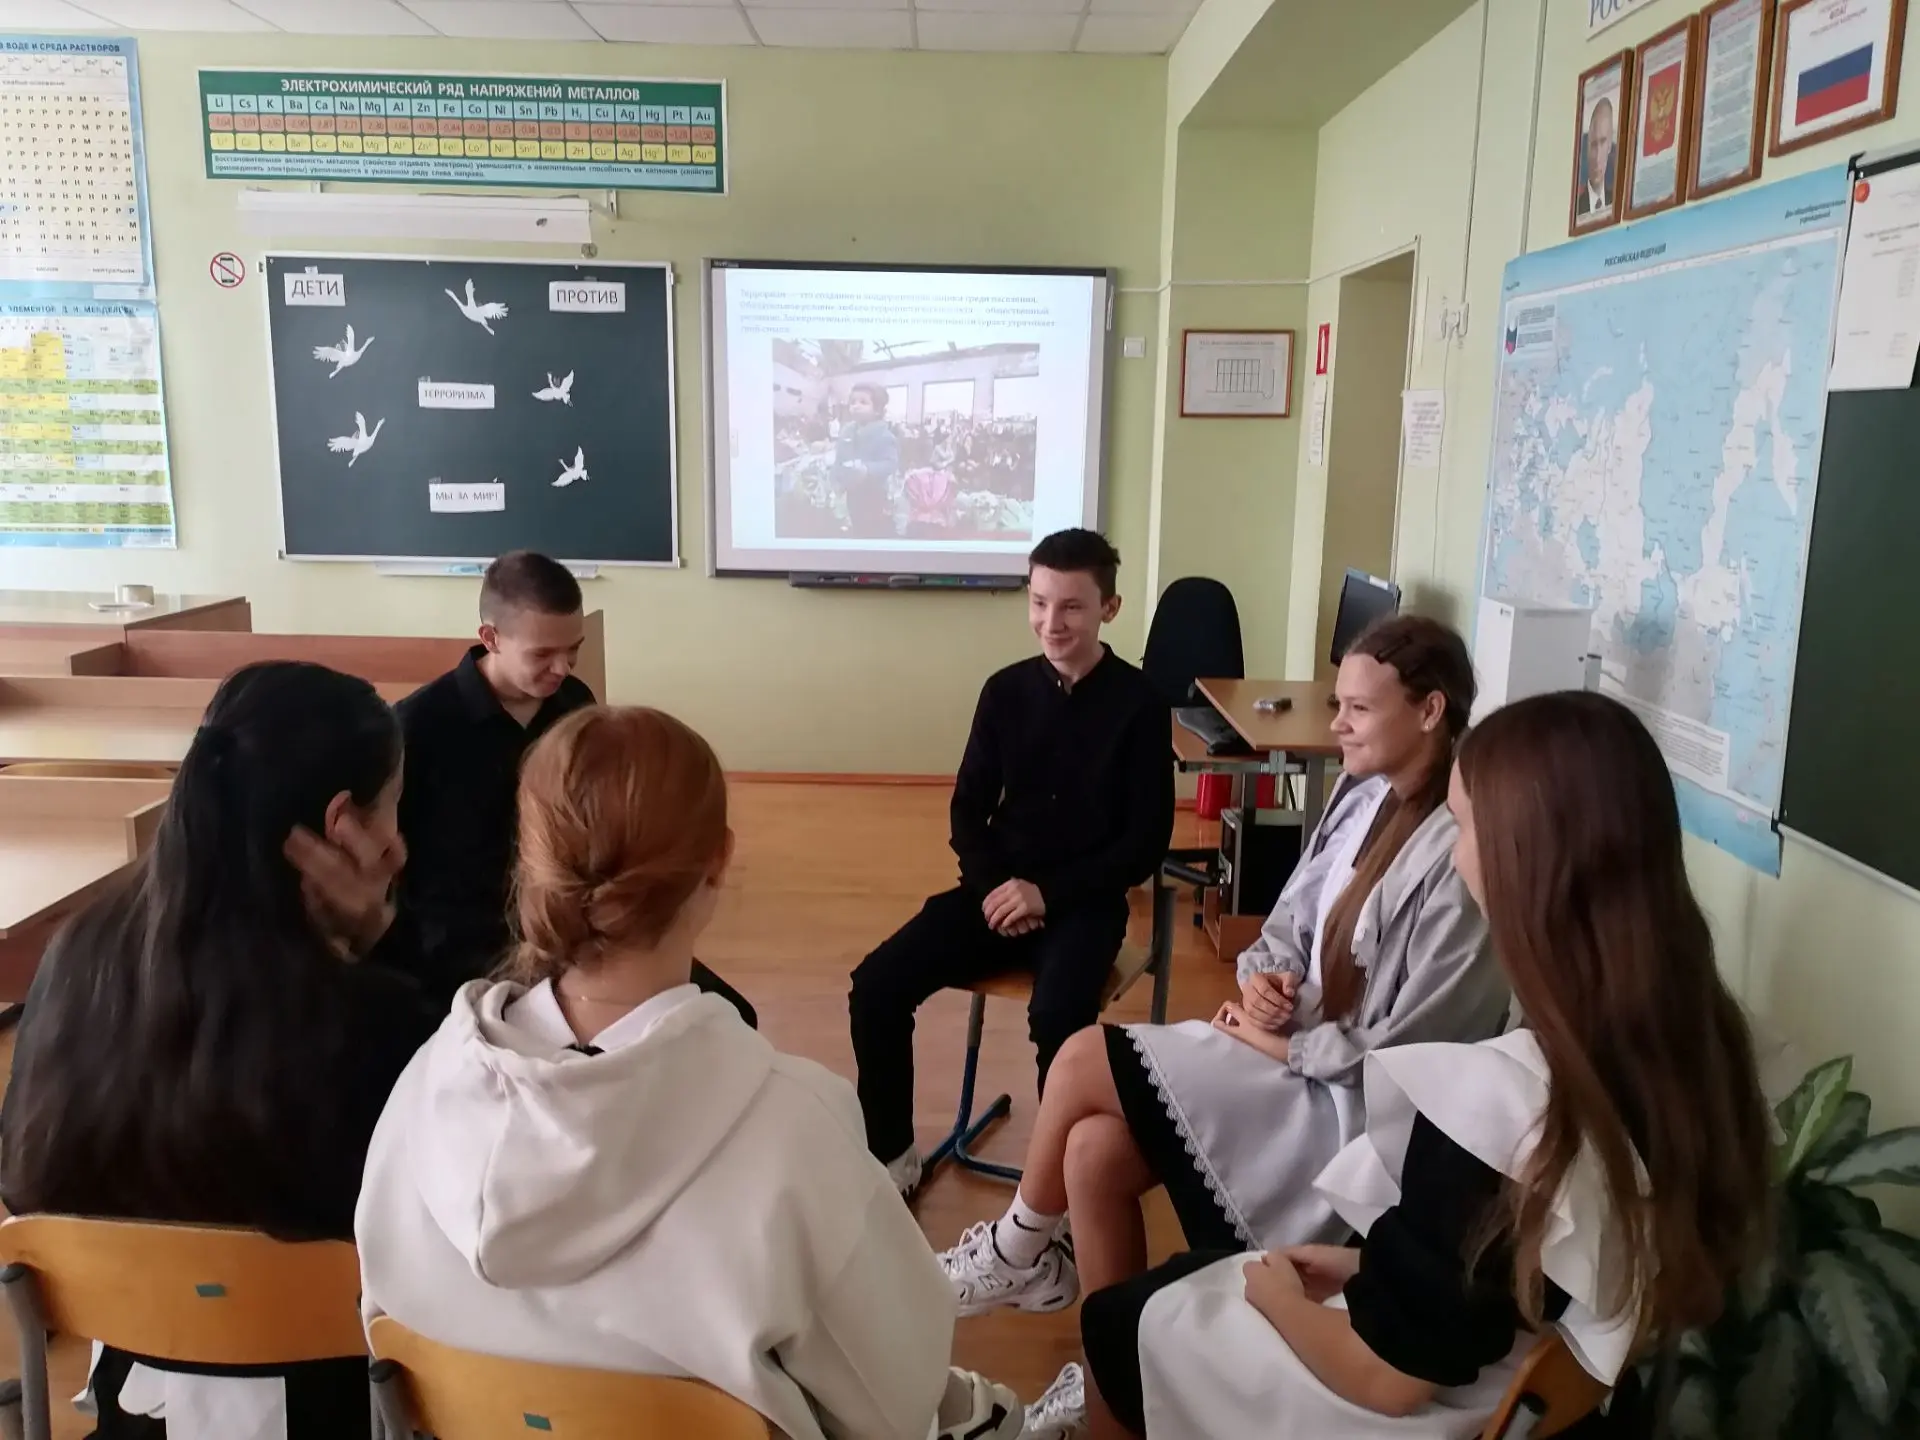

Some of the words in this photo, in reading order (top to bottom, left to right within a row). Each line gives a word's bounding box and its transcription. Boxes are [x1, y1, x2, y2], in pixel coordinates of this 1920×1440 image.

[6, 42, 29, 50] ВОДЕ
[40, 43, 67, 51] СРЕДА
[70, 43, 120, 52] РАСТВОРОВ
[281, 78, 432, 95] ЭЛЕКТРОХИМИЧЕСКИЙ
[438, 83, 464, 97] РЯД
[470, 83, 563, 99] НАПРЯЖЕНИЙ
[568, 86, 640, 100] МЕТАЛЛОВ
[215, 97, 224, 108] Li
[239, 99, 252, 108] Cs
[266, 99, 273, 108] K
[289, 100, 303, 110] Ba
[315, 100, 328, 110] Ca
[340, 101, 354, 111] Na
[365, 102, 381, 113] Mg
[393, 102, 404, 112] Al
[417, 103, 430, 113] Zn
[443, 103, 455, 113] Fe
[468, 104, 482, 114] Co
[495, 105, 506, 115] Ni
[519, 105, 532, 116] Sn
[545, 105, 558, 116] Pb
[595, 108, 609, 118] Cu
[620, 109, 635, 120] Ag
[646, 110, 660, 121] Hg
[672, 110, 683, 120] Pt
[696, 111, 710, 121] Au
[291, 280, 340, 299] ДЕТИ
[556, 289, 618, 305] ПРОТИВ
[424, 389, 486, 401] ТЕРРОРИЗМА
[435, 492, 453, 501] МЫ
[458, 491, 469, 501] ЗА
